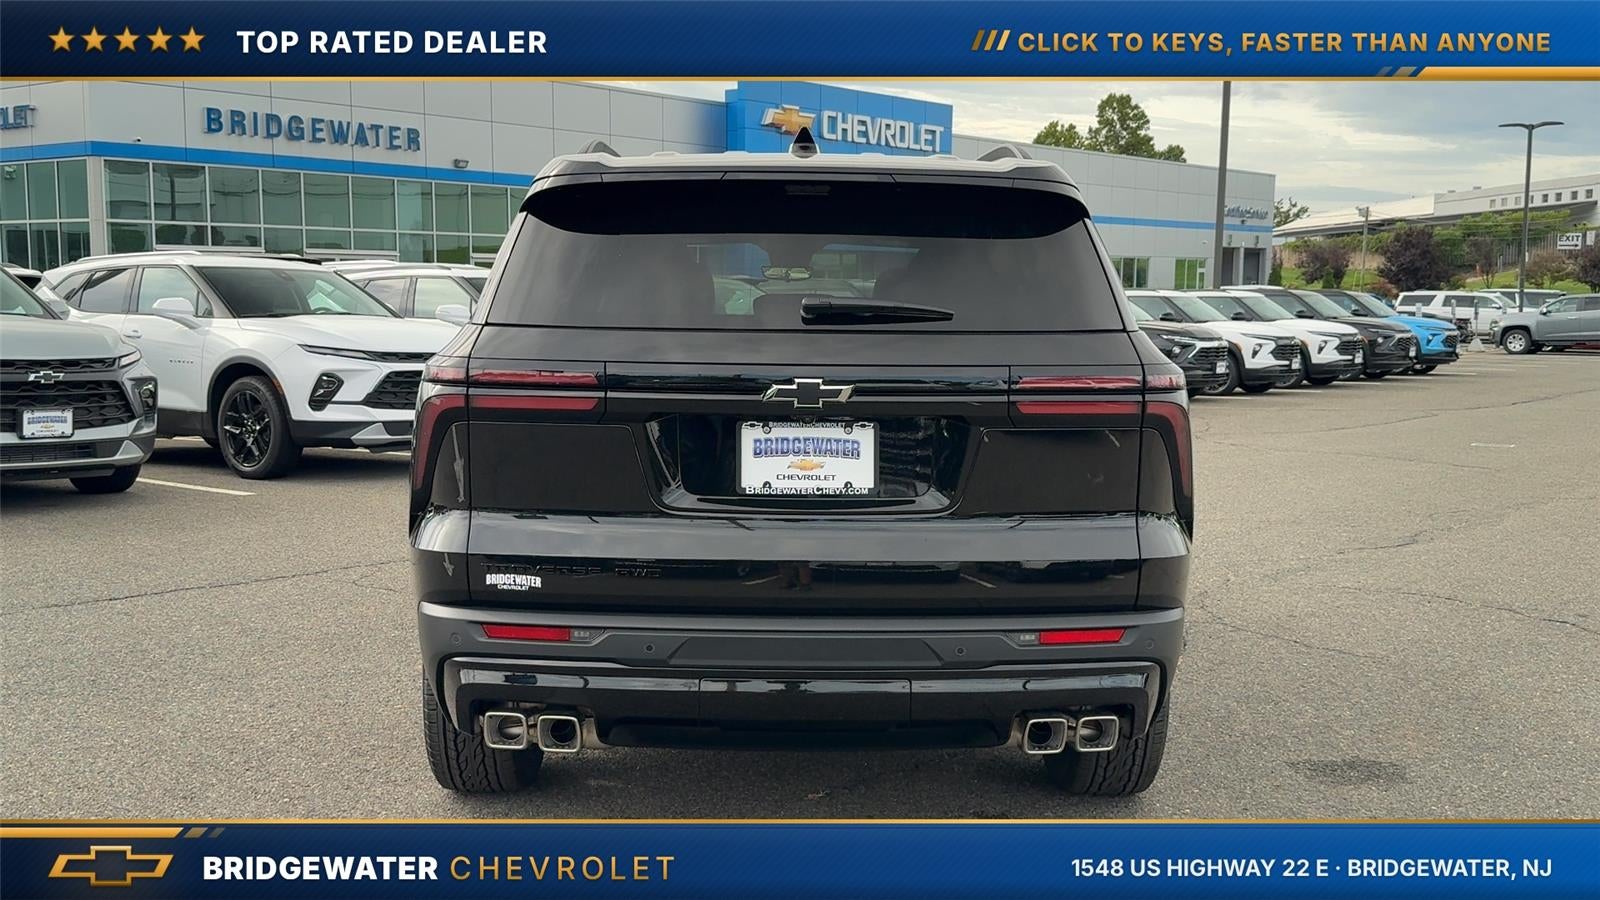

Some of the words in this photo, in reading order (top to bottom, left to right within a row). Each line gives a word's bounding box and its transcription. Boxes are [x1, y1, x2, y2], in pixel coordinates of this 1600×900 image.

[204, 107, 421, 151] BRIDGEWATER
[822, 110, 944, 153] CHEVROLET
[1559, 234, 1580, 242] EXIT
[753, 436, 861, 460] BRIDGEWATER
[776, 473, 837, 482] CHEVROLET
[745, 485, 869, 495] BRIDGEWATERCHEVY.COM
[485, 573, 542, 588] BRIDGEWATER
